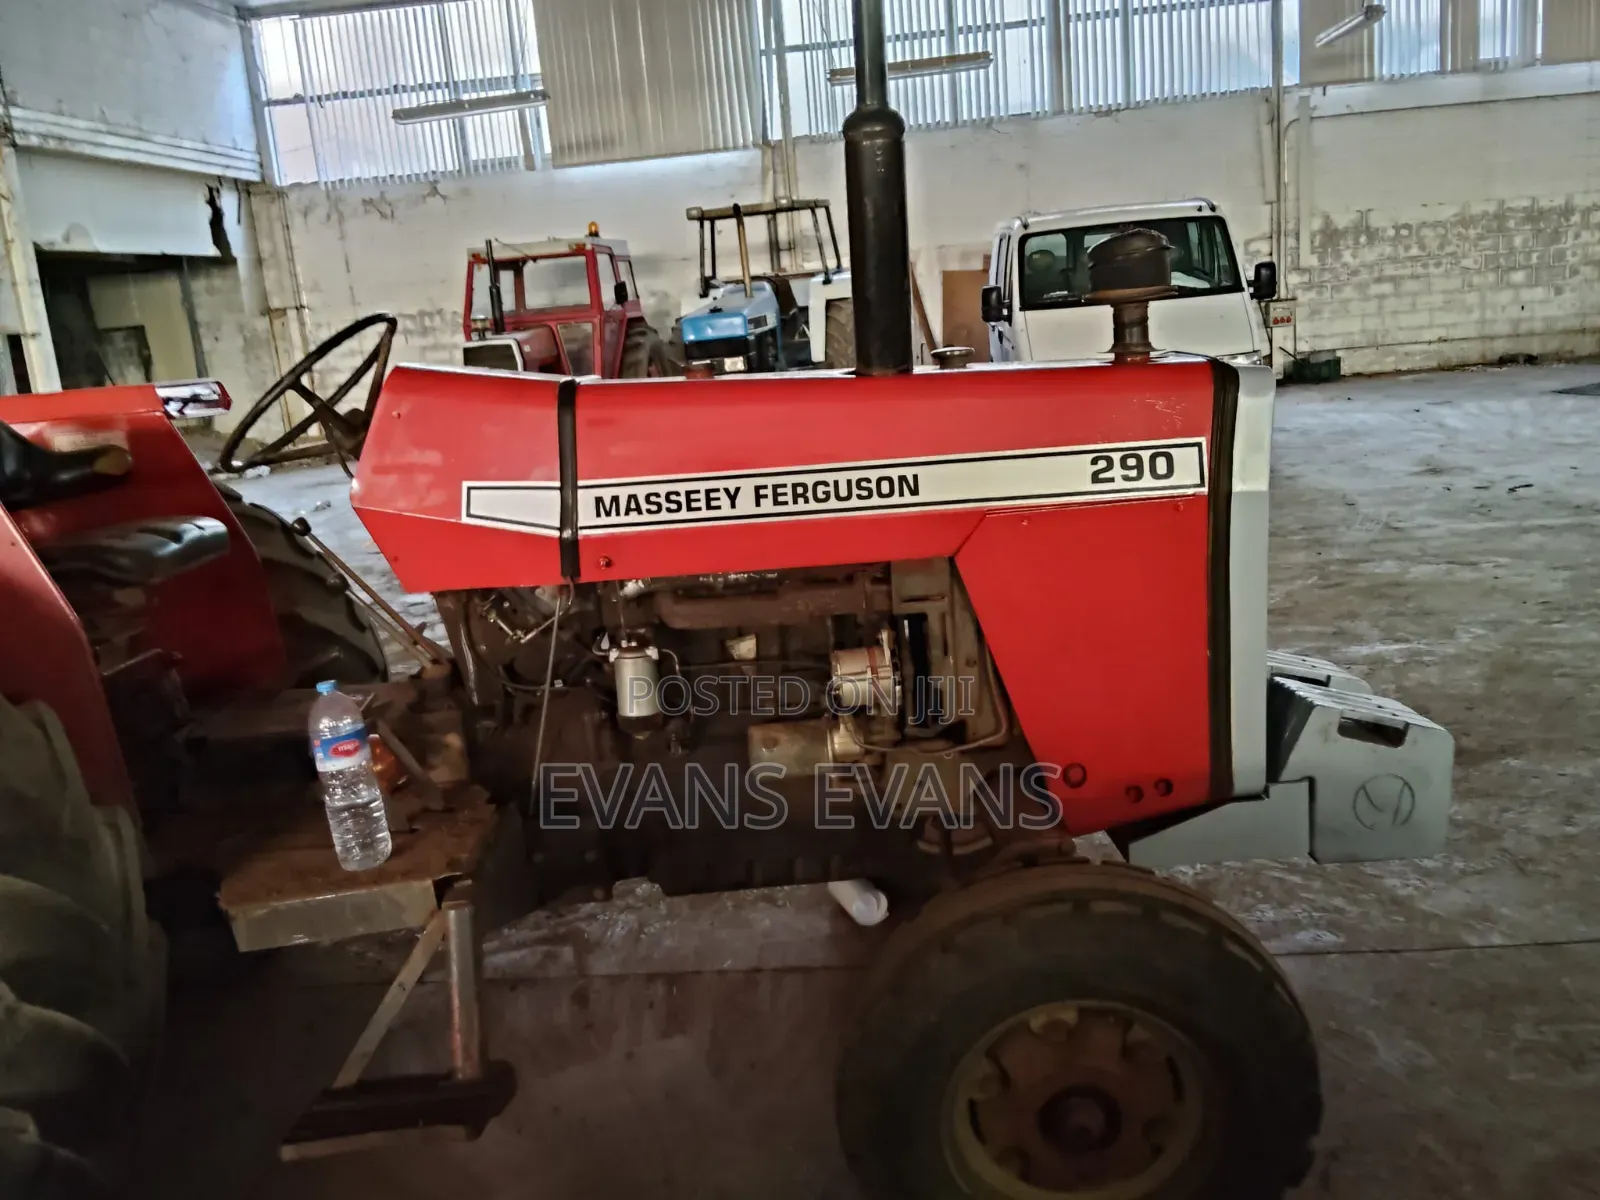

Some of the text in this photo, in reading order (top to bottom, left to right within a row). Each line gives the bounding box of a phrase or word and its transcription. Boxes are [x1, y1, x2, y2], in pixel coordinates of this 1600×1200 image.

[1090, 451, 1174, 484] 290
[594, 473, 920, 518] MASSEEY FERGUSON
